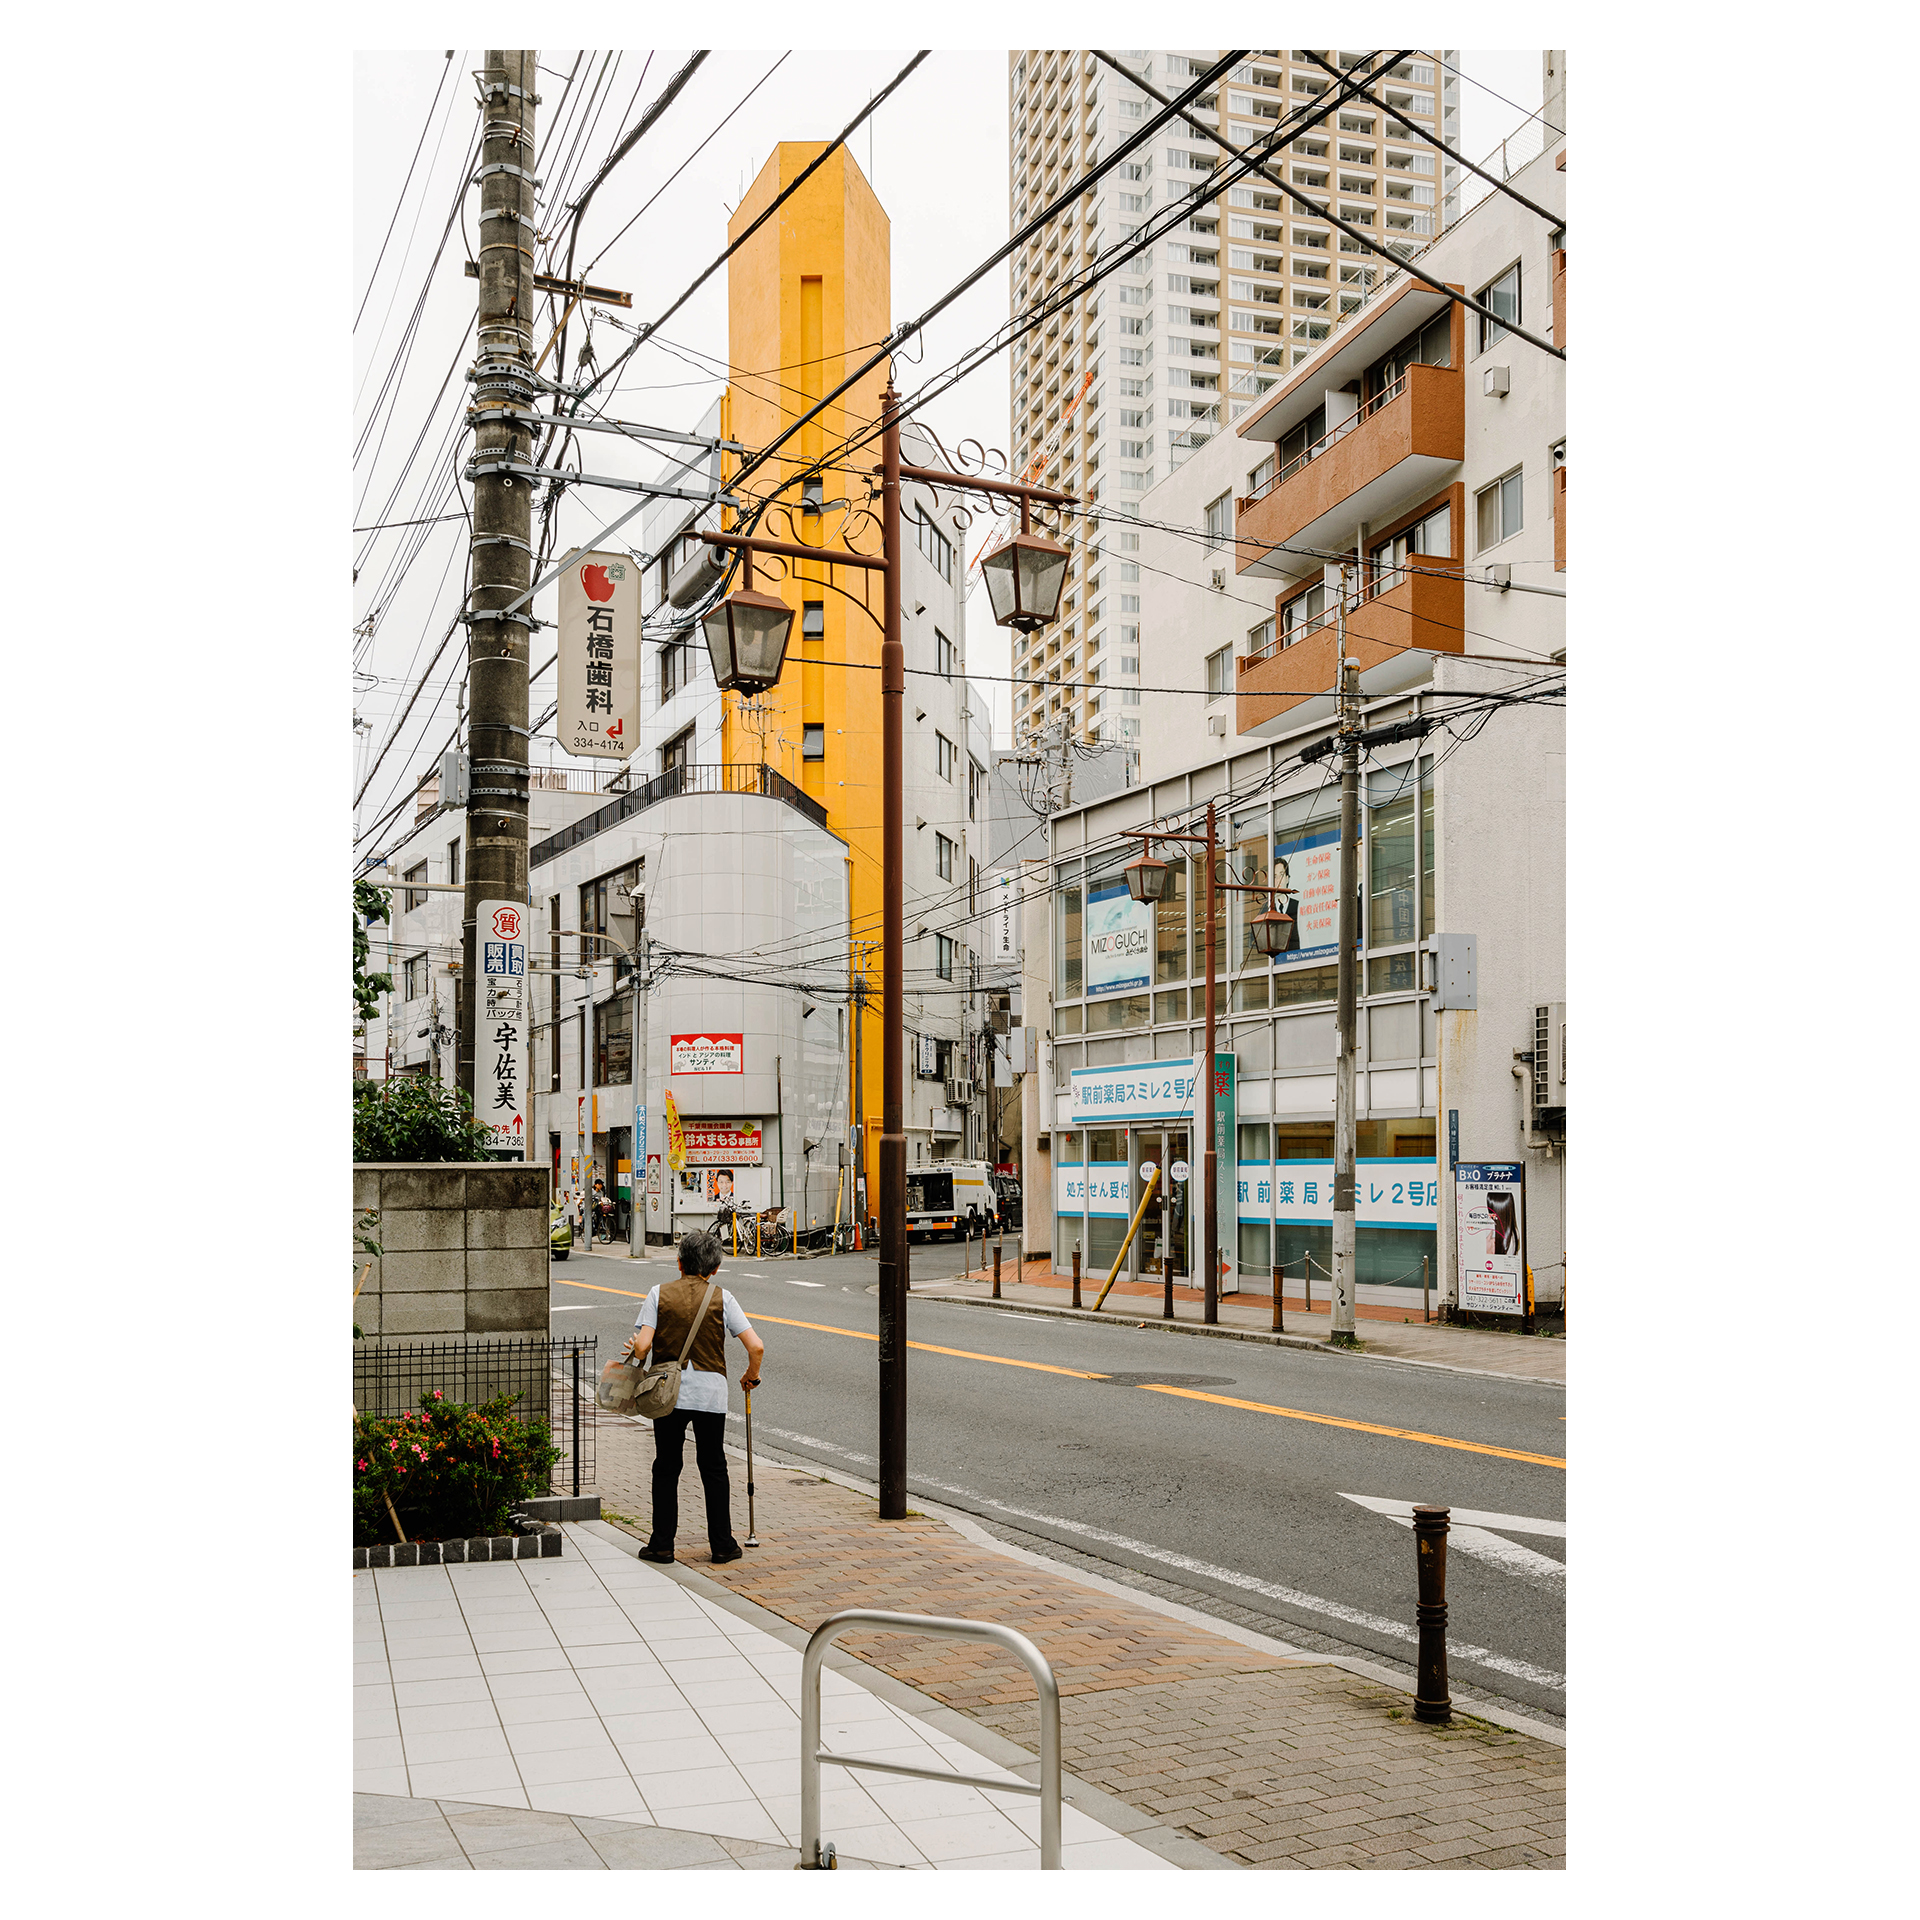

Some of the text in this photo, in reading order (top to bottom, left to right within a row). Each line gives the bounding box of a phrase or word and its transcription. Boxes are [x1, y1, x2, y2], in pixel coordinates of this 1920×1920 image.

[585, 605, 615, 716] 石橋歯科
[577, 720, 599, 732] 入口
[573, 737, 625, 752] 334-4174
[1305, 851, 1332, 867] 生命保険
[1306, 868, 1331, 882] ガン保険
[1302, 883, 1335, 900] 自動車保険
[1299, 899, 1339, 917] 賠償責任保険
[499, 913, 516, 934] 質
[1305, 917, 1332, 932] 火災保険
[1091, 929, 1148, 955] MIZOGUCHI
[486, 943, 504, 973] 販売
[511, 944, 524, 976] 買取
[1286, 945, 1339, 961] http://www.mizoguchi
[486, 1009, 523, 1020] バッグ他
[492, 1022, 519, 1112] 宇佐美
[689, 1058, 716, 1066] サンティ
[1214, 1071, 1230, 1097] 薬
[1466, 1295, 1502, 1304] 047-322-5611
